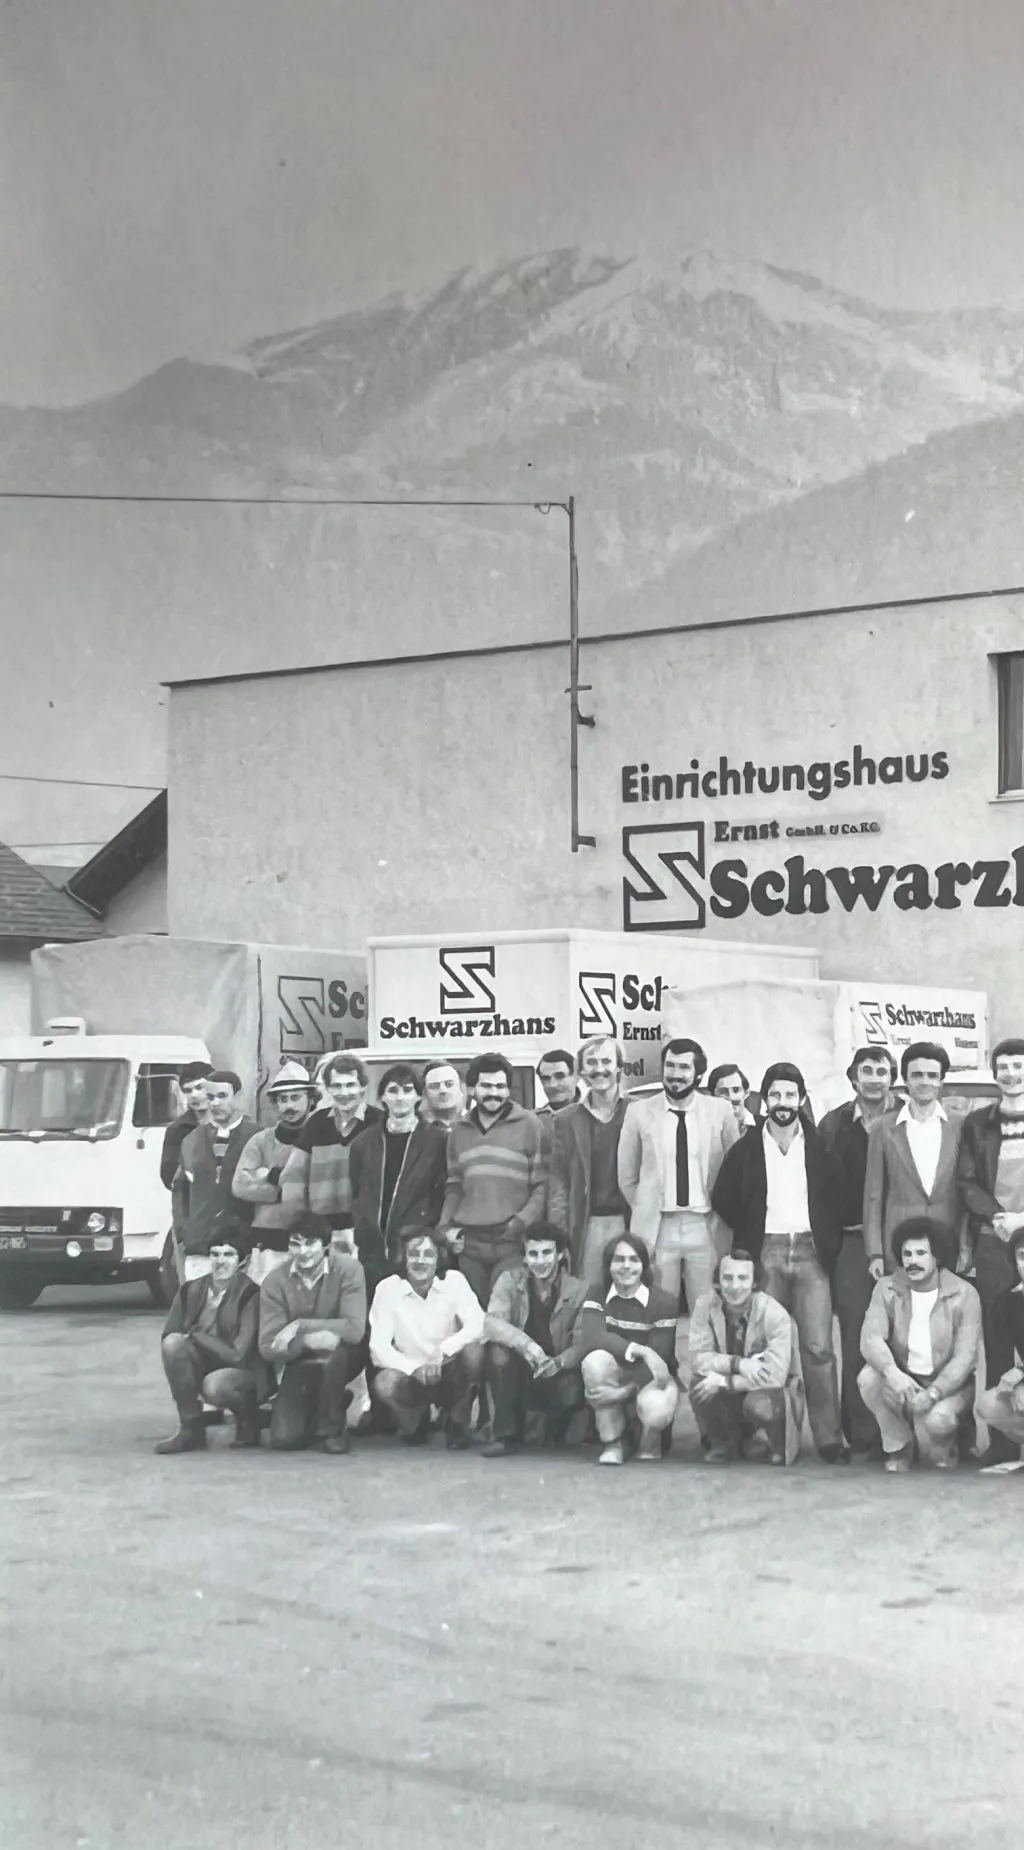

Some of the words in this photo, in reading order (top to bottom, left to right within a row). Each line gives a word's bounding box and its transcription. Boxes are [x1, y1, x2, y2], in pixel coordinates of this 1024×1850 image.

[621, 744, 950, 803] Einrichtungshaus
[714, 820, 780, 842] Ernst
[380, 1014, 556, 1040] Schwarzhans
